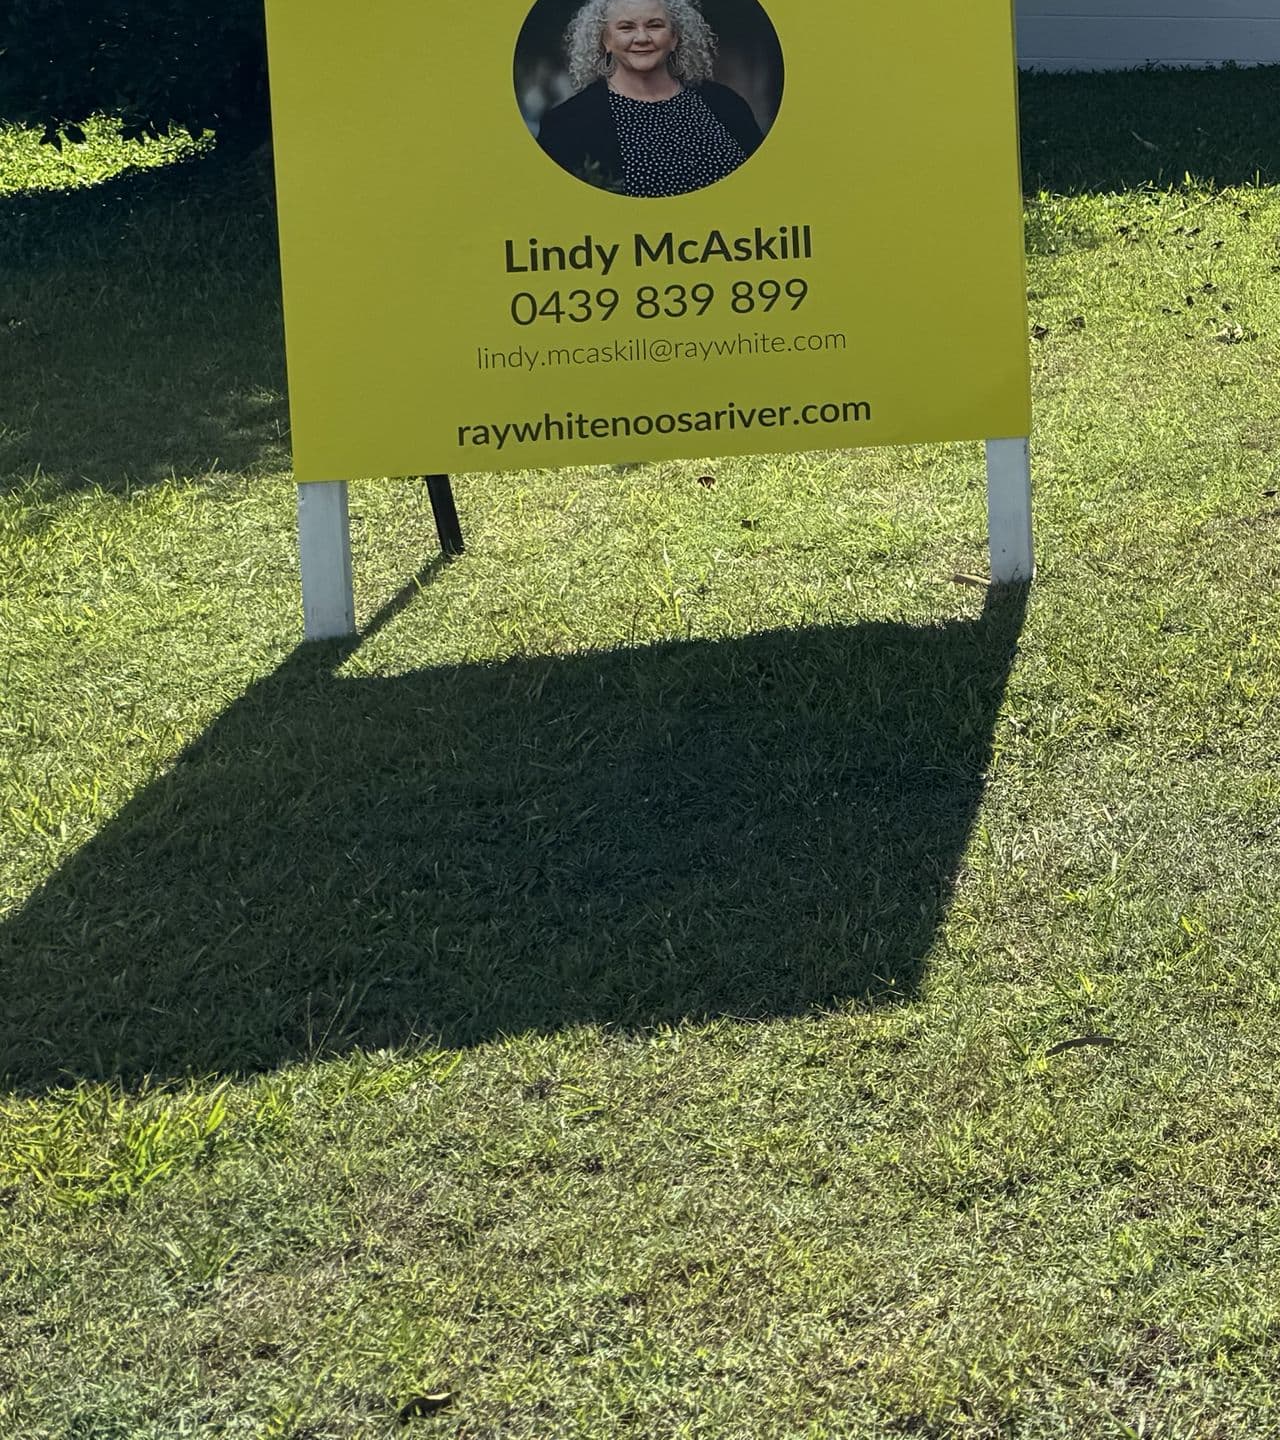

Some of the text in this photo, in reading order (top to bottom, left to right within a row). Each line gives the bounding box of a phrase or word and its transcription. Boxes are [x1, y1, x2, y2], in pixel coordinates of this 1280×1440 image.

[505, 225, 812, 276] Lindy McAskill
[510, 278, 809, 326] 0439 839 899
[477, 329, 847, 371] lindy.mcaskill@raywhite.com
[457, 400, 871, 450] raywhitenoosariver.com
